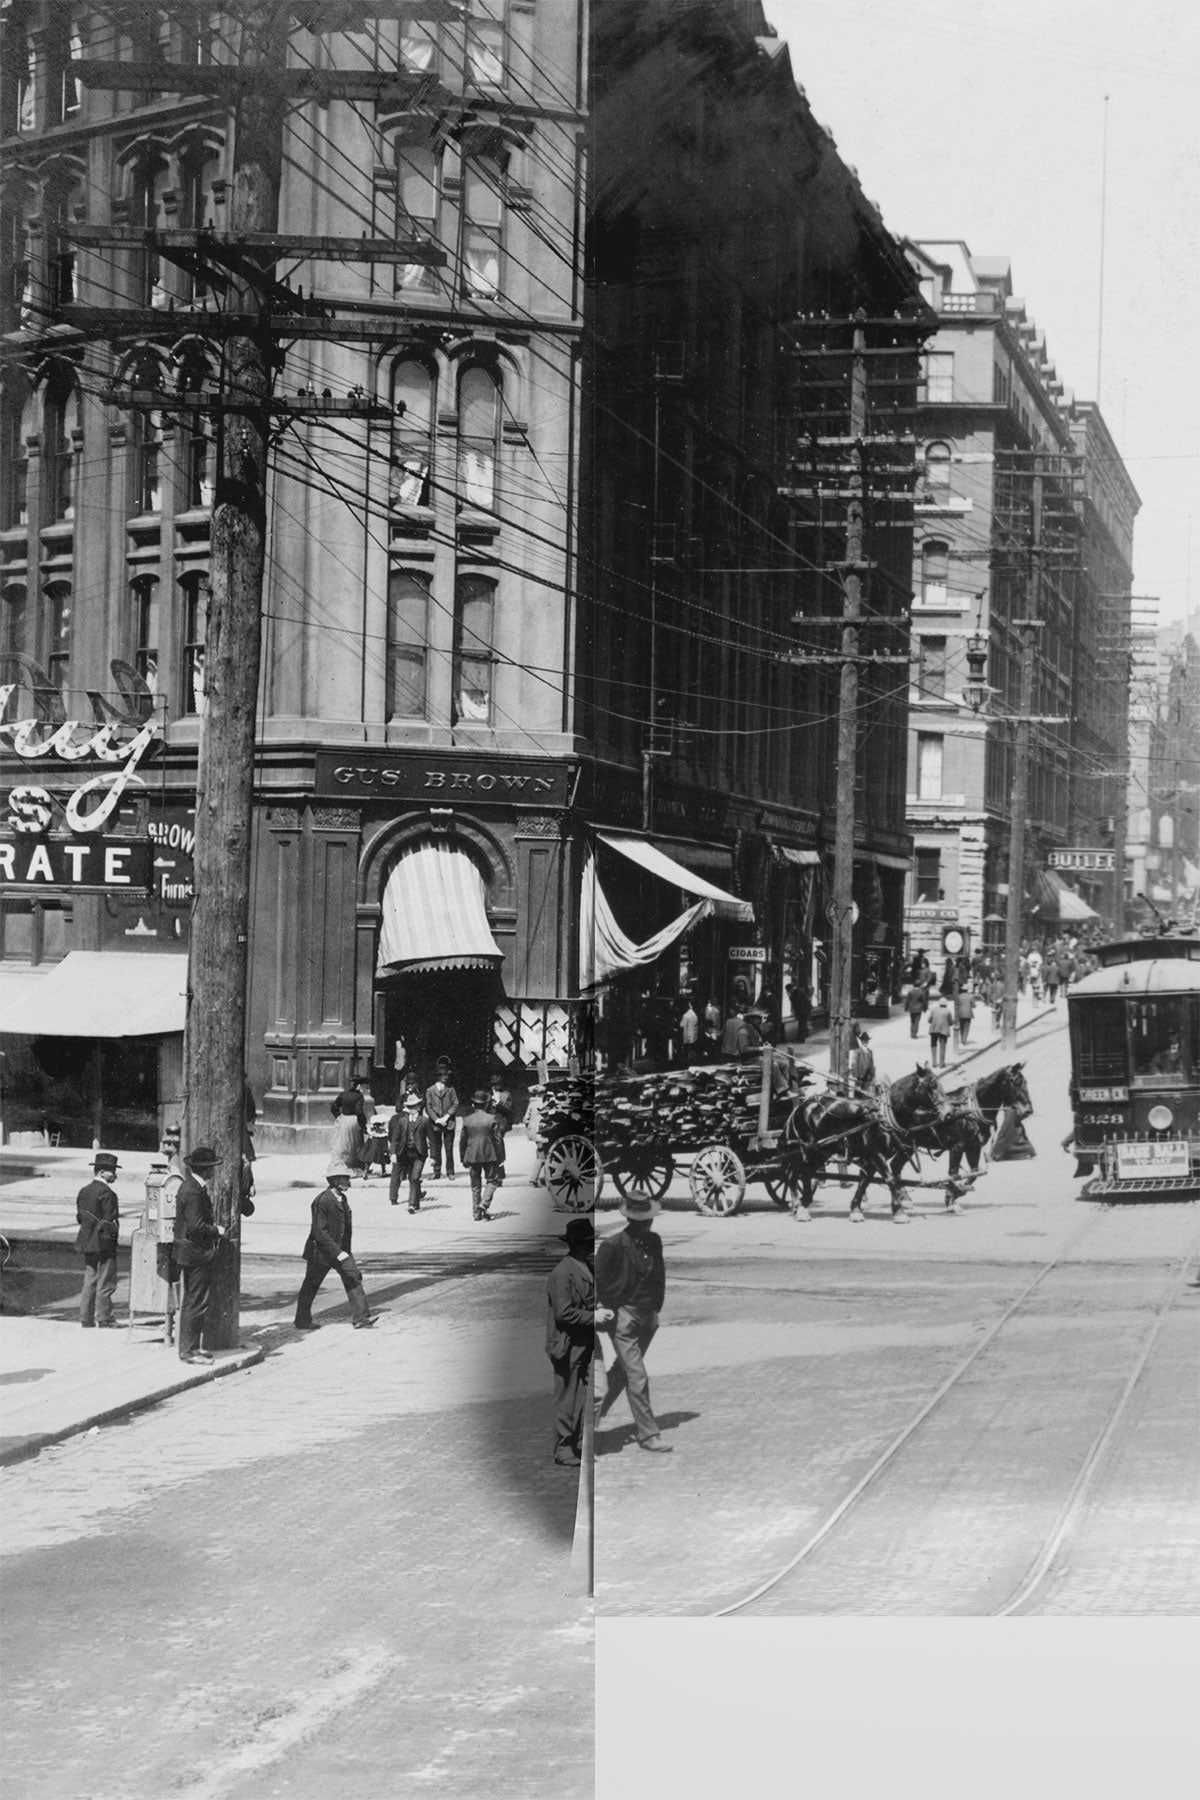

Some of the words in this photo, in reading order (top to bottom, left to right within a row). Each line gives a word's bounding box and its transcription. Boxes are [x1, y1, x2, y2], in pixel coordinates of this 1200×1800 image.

[333, 766, 400, 785] GUS
[424, 771, 555, 794] BROWN
[148, 822, 196, 858] BROW
[729, 948, 764, 959] CIGARS
[1083, 1114, 1124, 1125] 328
